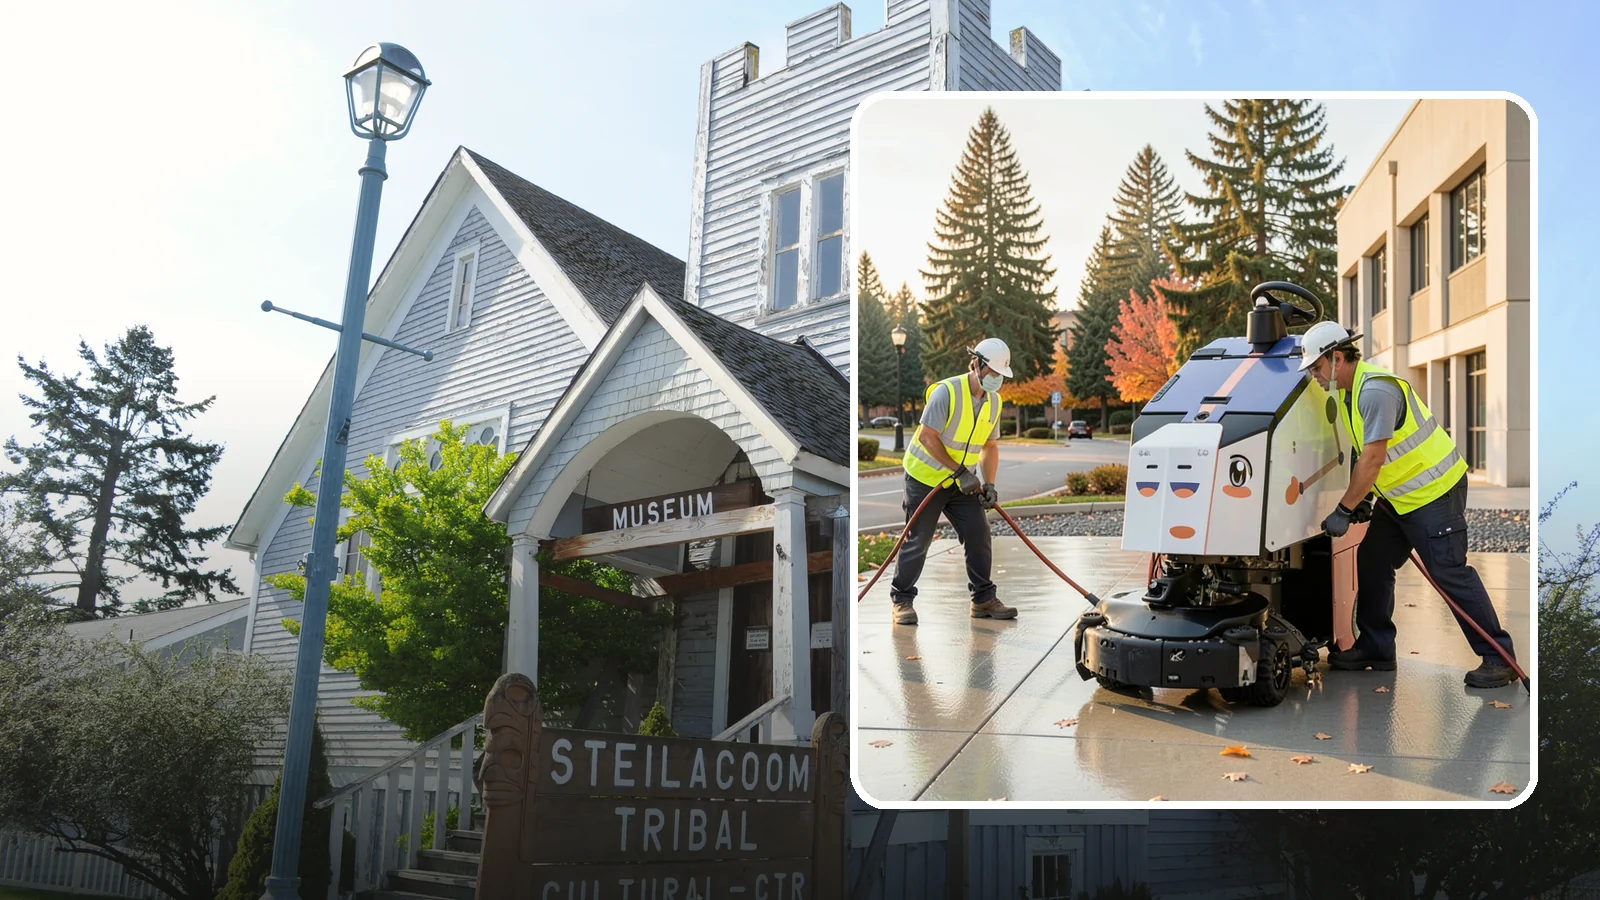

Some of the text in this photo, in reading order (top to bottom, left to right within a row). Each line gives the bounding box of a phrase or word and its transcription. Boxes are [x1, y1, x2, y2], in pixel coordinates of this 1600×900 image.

[613, 491, 713, 531] MUSEUM
[550, 738, 810, 792] STEILACOOM
[614, 806, 758, 852] TRIBAL
